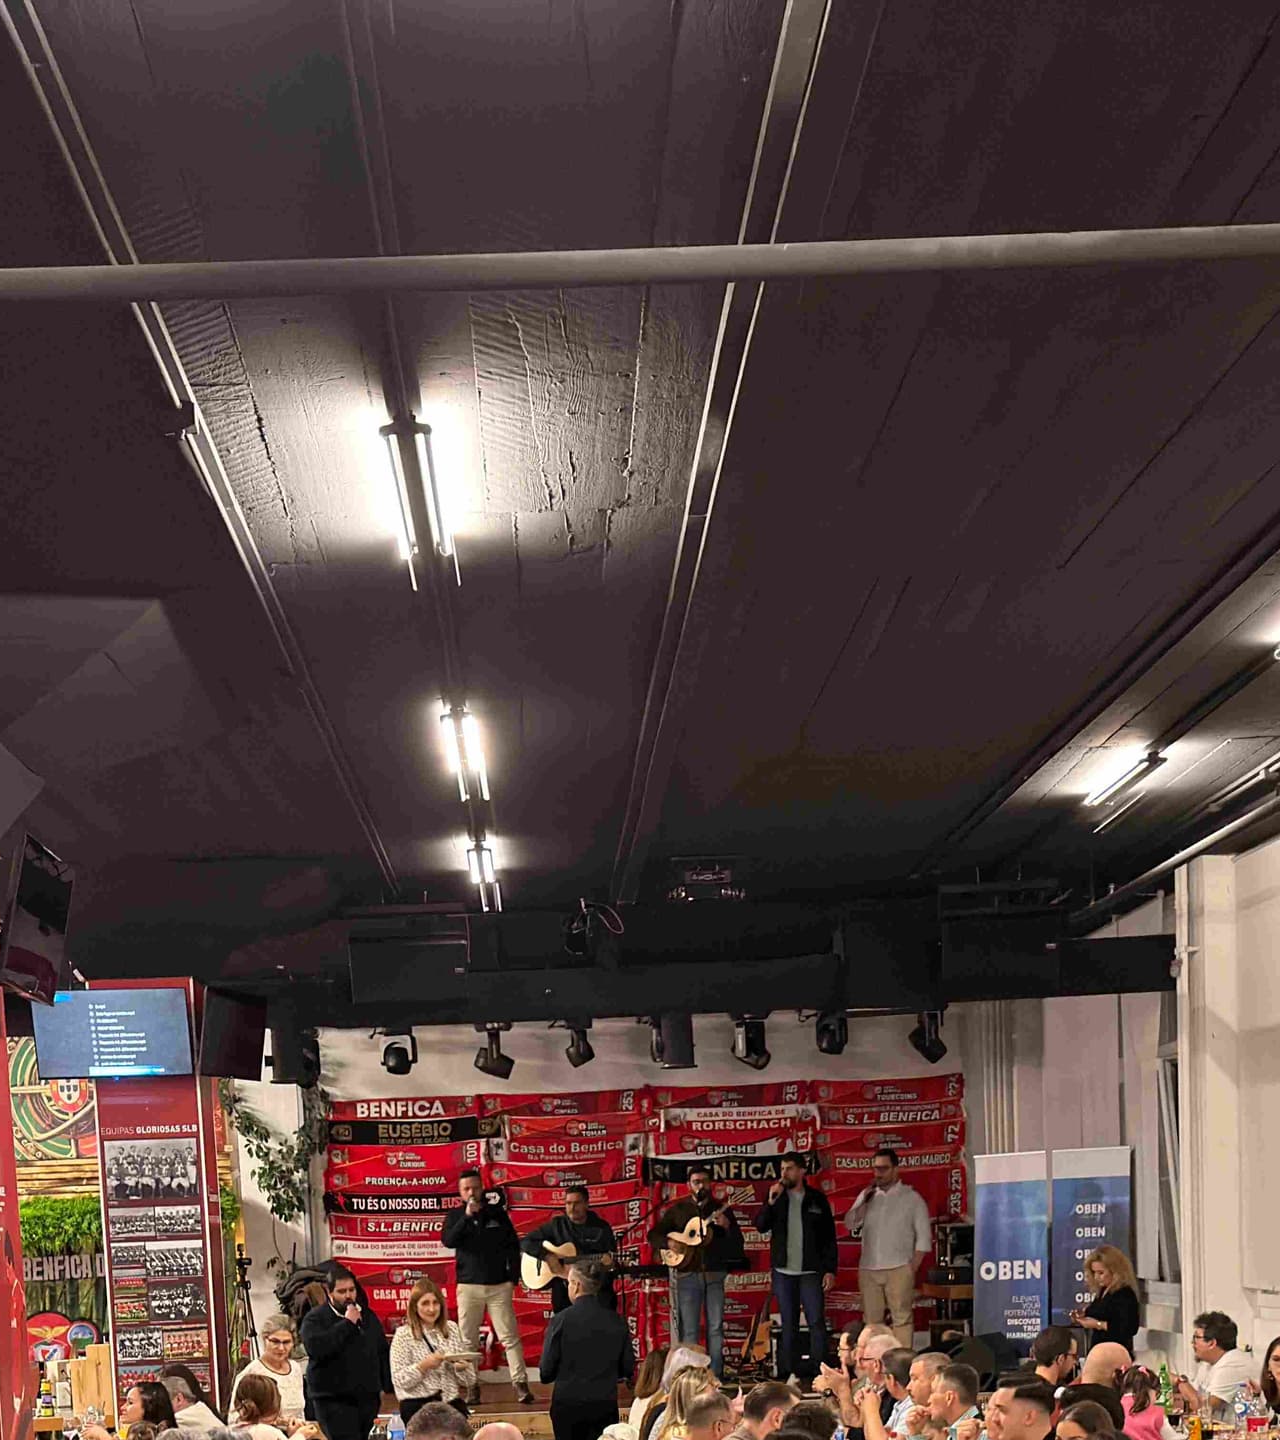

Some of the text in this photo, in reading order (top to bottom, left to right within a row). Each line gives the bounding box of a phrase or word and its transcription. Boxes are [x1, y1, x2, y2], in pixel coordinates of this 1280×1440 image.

[785, 1084, 798, 1101] 25
[622, 1090, 634, 1111] 253
[356, 1100, 445, 1118] BENFICA
[846, 1109, 941, 1124] S. L. BENFICA
[100, 1123, 198, 1136] EQUIPAS GLORIOSAS SLB
[378, 1122, 452, 1138] EUSÉBIO
[692, 1119, 791, 1131] RORSCHACH
[467, 1142, 478, 1163] 100
[510, 1140, 623, 1154] Casa do Benfica
[696, 1145, 756, 1156] PENICHE
[836, 1158, 858, 1169] CASA
[859, 1157, 870, 1168] DO
[909, 1156, 920, 1167] NO
[687, 1162, 776, 1180] NFICA
[365, 1176, 447, 1188] PROENÇA-A-NOVA
[352, 1198, 366, 1210] TU
[367, 1196, 380, 1210] ÉS
[380, 1198, 387, 1210] O
[388, 1198, 420, 1210] NOSSO
[421, 1197, 440, 1210] REI,
[1075, 1203, 1106, 1214] OBEN
[628, 1200, 640, 1222] 168
[367, 1221, 443, 1232] S.L.BENFIC
[1075, 1226, 1106, 1238] OBEN
[23, 1253, 106, 1281] BENFICA D
[980, 1259, 1041, 1281] OBEN
[373, 1288, 397, 1300] CASA
[1012, 1295, 1041, 1303] ELEVATE
[1021, 1302, 1041, 1310] YOUR
[1004, 1309, 1041, 1317] POTENTIAL
